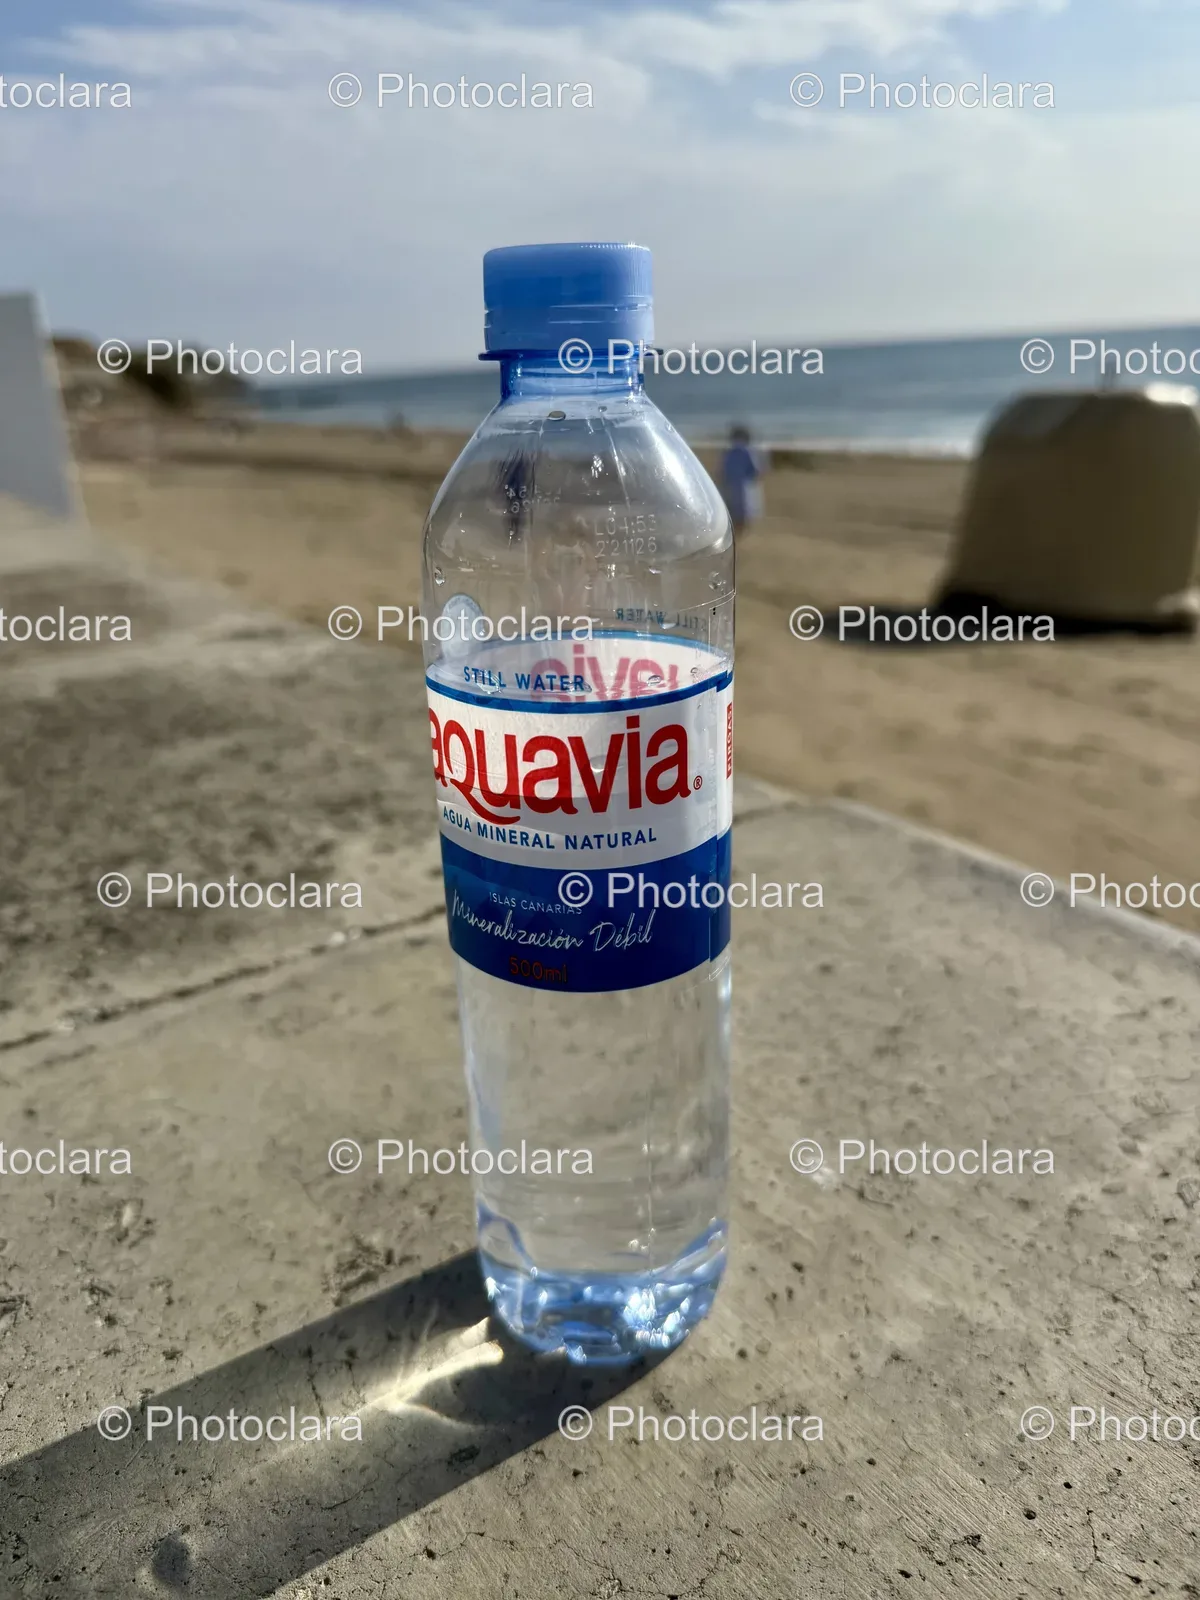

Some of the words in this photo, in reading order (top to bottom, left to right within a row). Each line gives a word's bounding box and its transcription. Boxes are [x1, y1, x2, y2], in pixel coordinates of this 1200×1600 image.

[463, 666, 507, 688] STILL
[515, 673, 585, 692] WATER
[443, 805, 472, 832] AGUA
[477, 821, 555, 849] MINERAL
[565, 827, 657, 850] NATURAL
[489, 892, 517, 908] ISLAS
[520, 900, 583, 915] CANARIAS
[452, 889, 584, 950] Mineralización
[589, 909, 657, 952] Débil
[509, 956, 568, 983] 500ml
